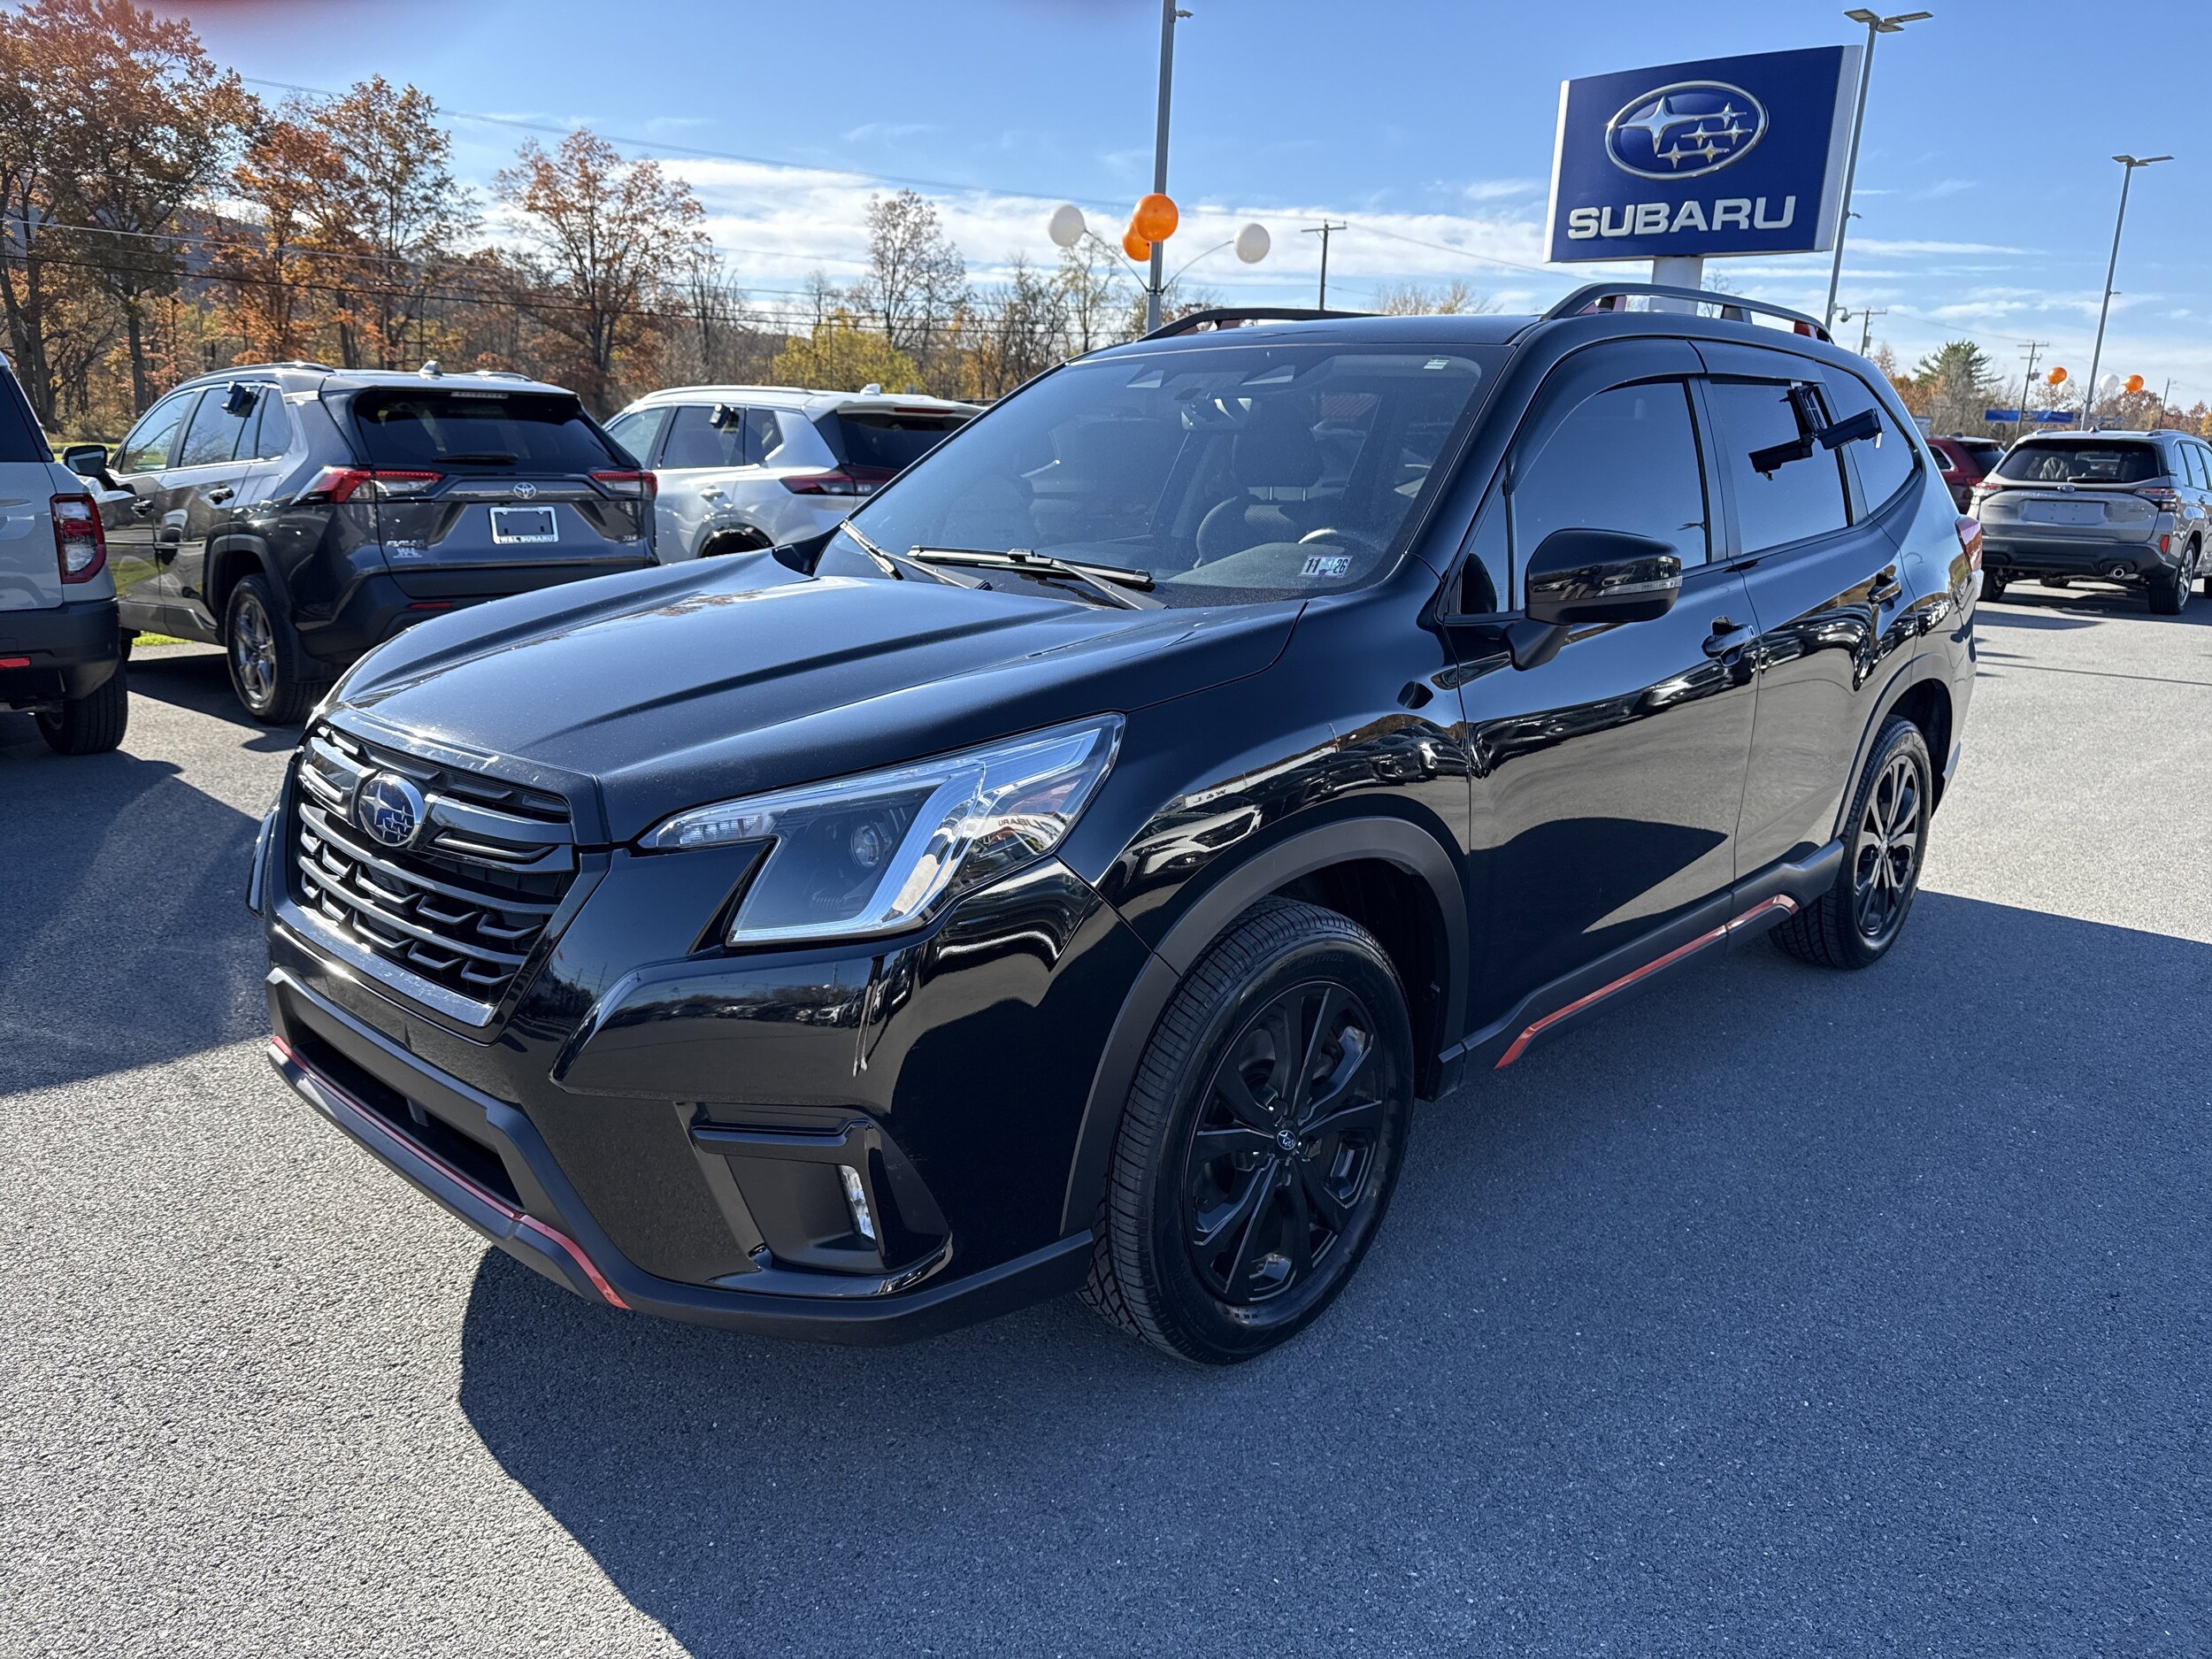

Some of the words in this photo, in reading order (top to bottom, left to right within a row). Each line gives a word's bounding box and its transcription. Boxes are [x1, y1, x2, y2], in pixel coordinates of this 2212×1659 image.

[1567, 195, 1797, 240] SUBARU
[1305, 557, 1322, 573] 11
[1333, 558, 1348, 573] 26
